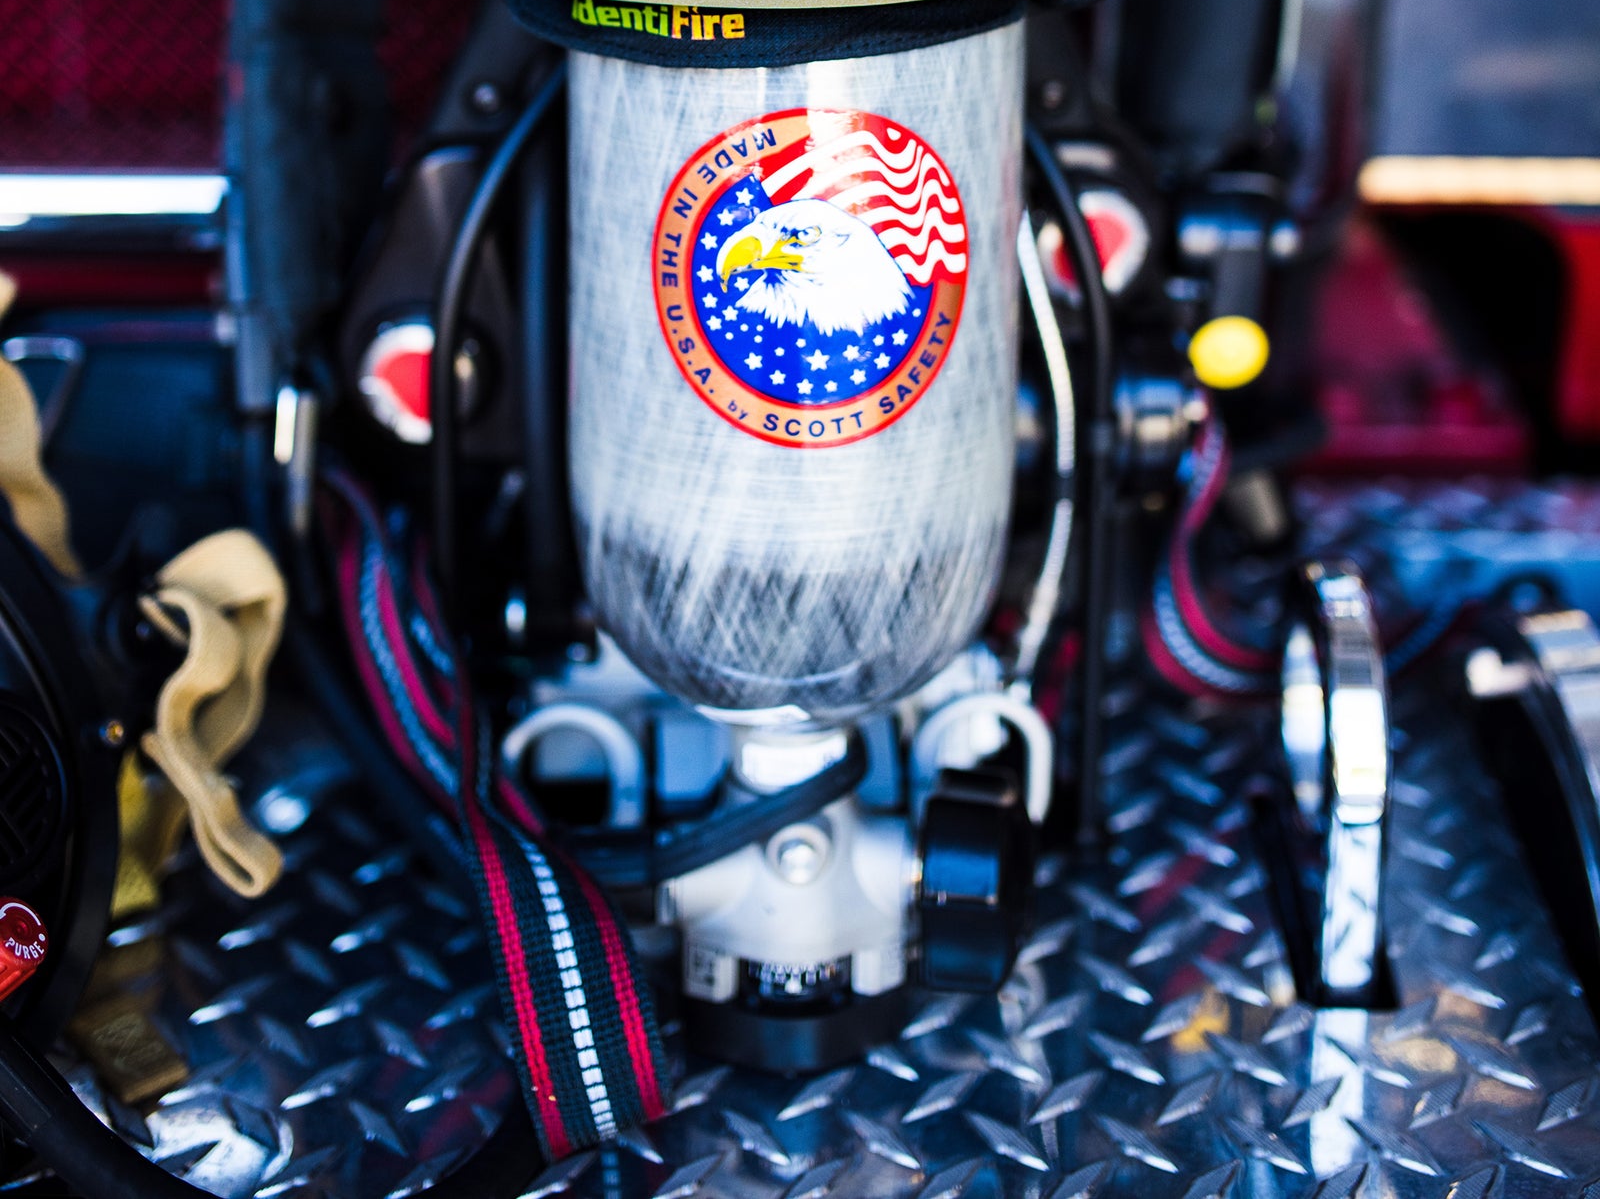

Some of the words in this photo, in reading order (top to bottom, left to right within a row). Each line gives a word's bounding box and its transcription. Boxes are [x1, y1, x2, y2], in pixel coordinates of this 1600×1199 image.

[697, 128, 777, 185] MADE
[673, 187, 699, 219] IN
[661, 233, 682, 288] THE
[666, 304, 715, 394] U.S.A.
[878, 311, 952, 414] SAFETY
[727, 400, 748, 420] by
[762, 411, 864, 438] SCOTT
[5, 937, 44, 959] PURGE
